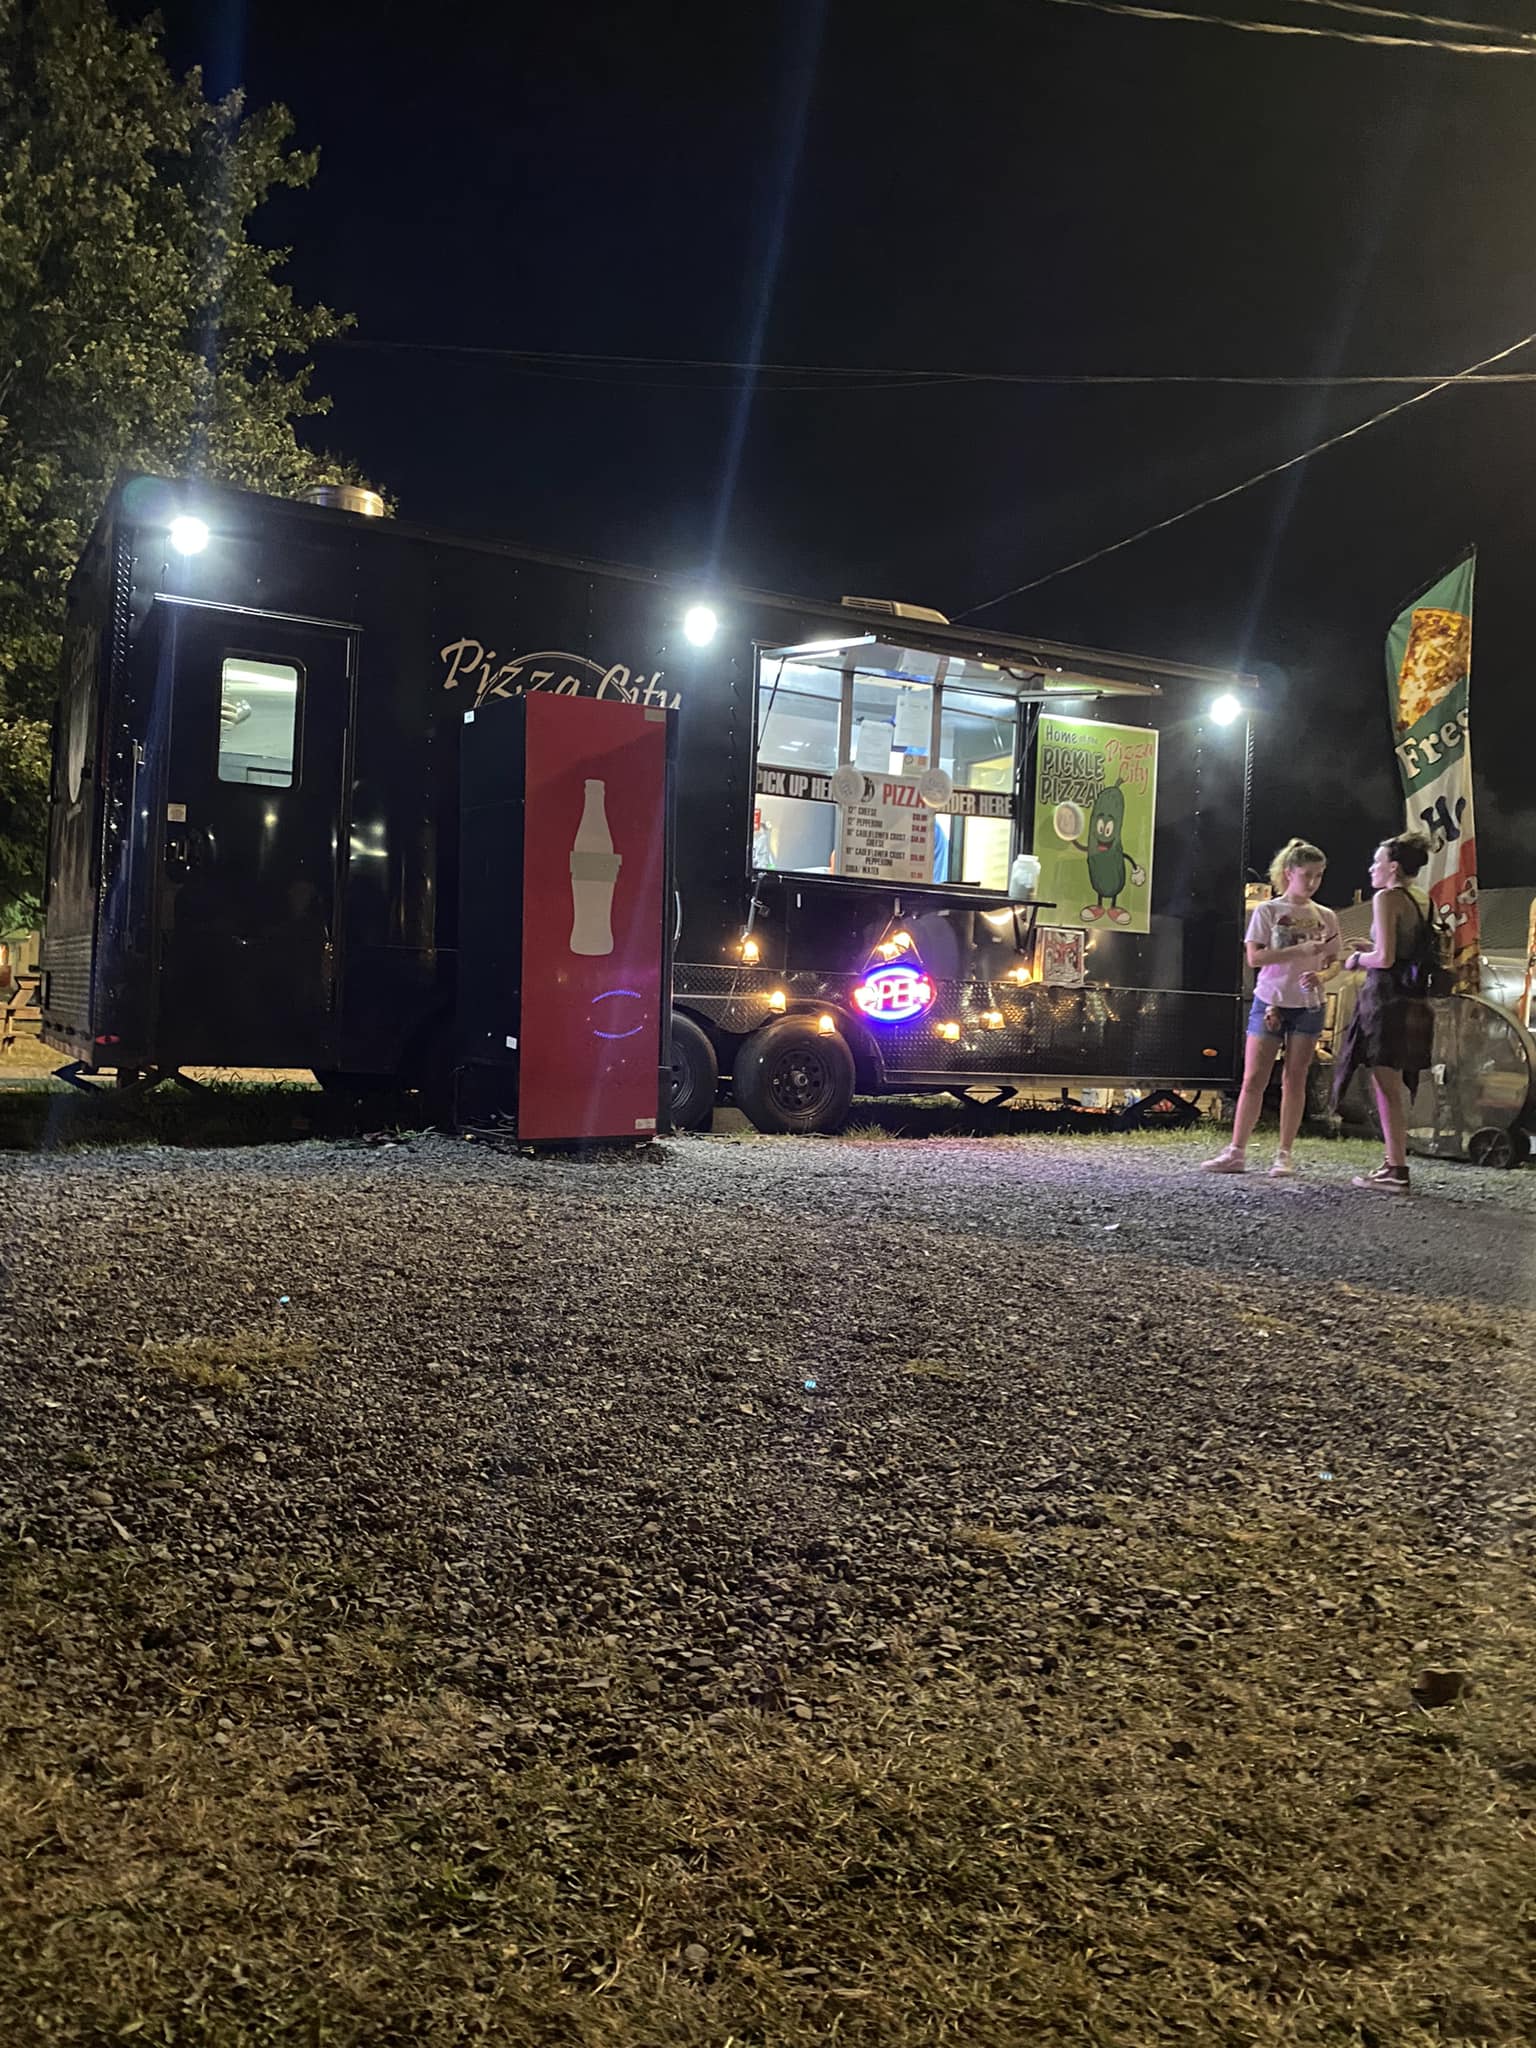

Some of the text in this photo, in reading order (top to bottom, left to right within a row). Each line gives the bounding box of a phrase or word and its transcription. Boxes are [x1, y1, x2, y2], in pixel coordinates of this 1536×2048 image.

[1046, 724, 1078, 745] Home
[1041, 745, 1105, 781] PICKLE
[1105, 738, 1153, 763] Pizza
[757, 770, 785, 795] PICK
[788, 774, 809, 798] UP
[811, 777, 833, 800] HE
[1119, 761, 1149, 795] City
[941, 792, 1013, 817] RDER HERE
